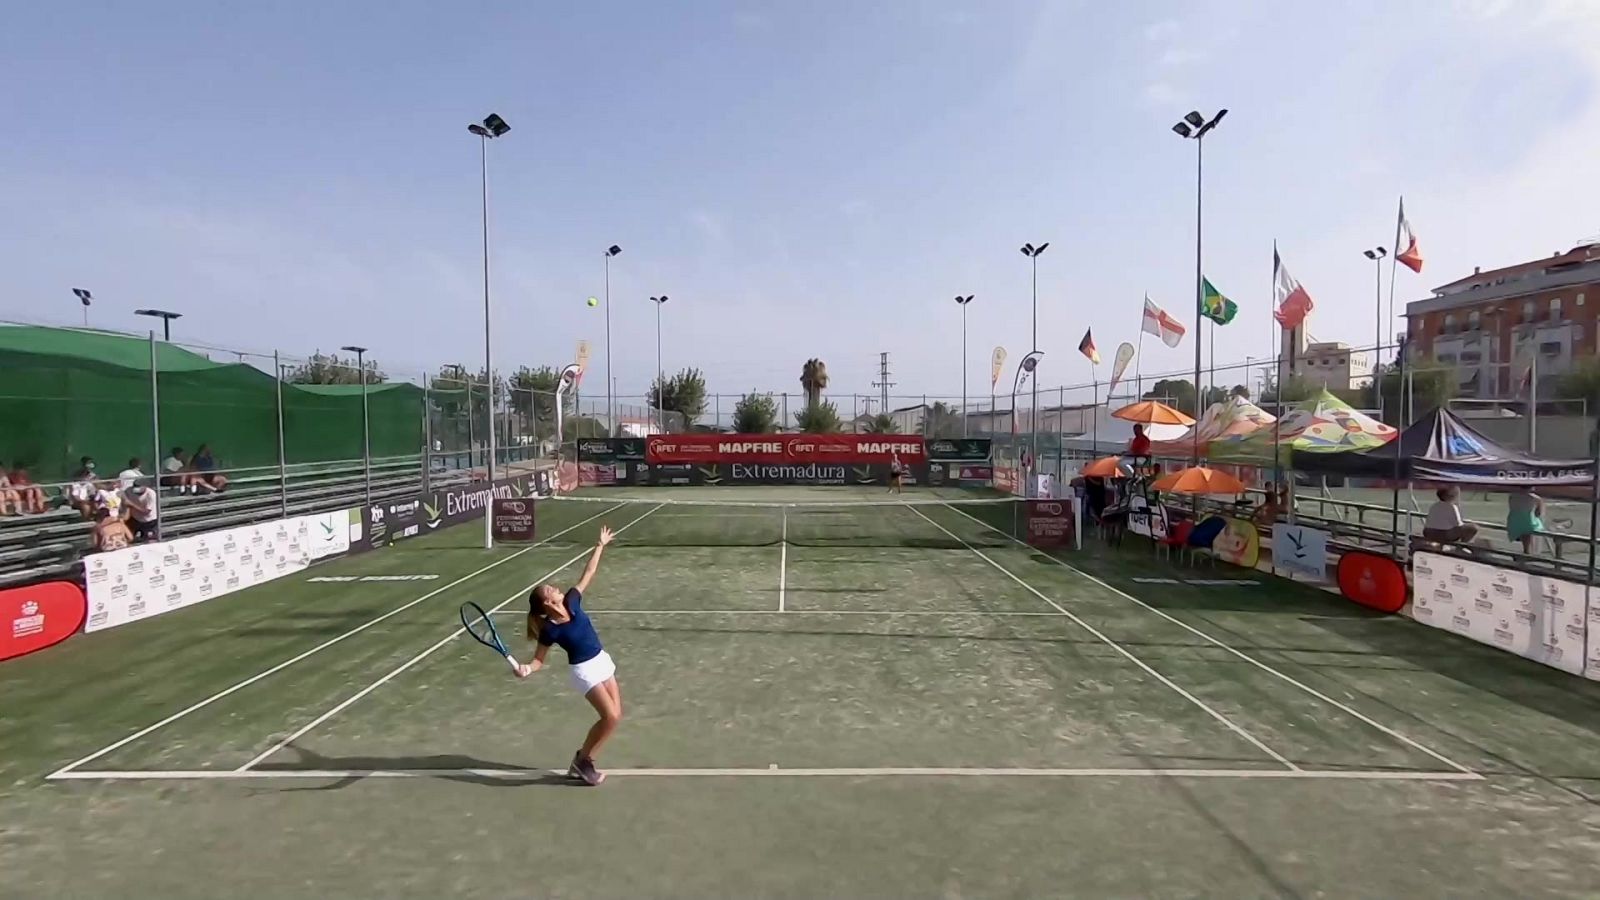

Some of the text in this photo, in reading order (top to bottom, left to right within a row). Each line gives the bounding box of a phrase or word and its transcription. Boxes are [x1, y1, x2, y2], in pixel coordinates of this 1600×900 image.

[656, 444, 677, 453] RFET
[719, 442, 782, 453] MAPFRE
[795, 444, 815, 453] RFET
[857, 442, 921, 454] MAPFRE
[732, 463, 845, 479] Extremadura
[447, 483, 512, 516] Extremadura
